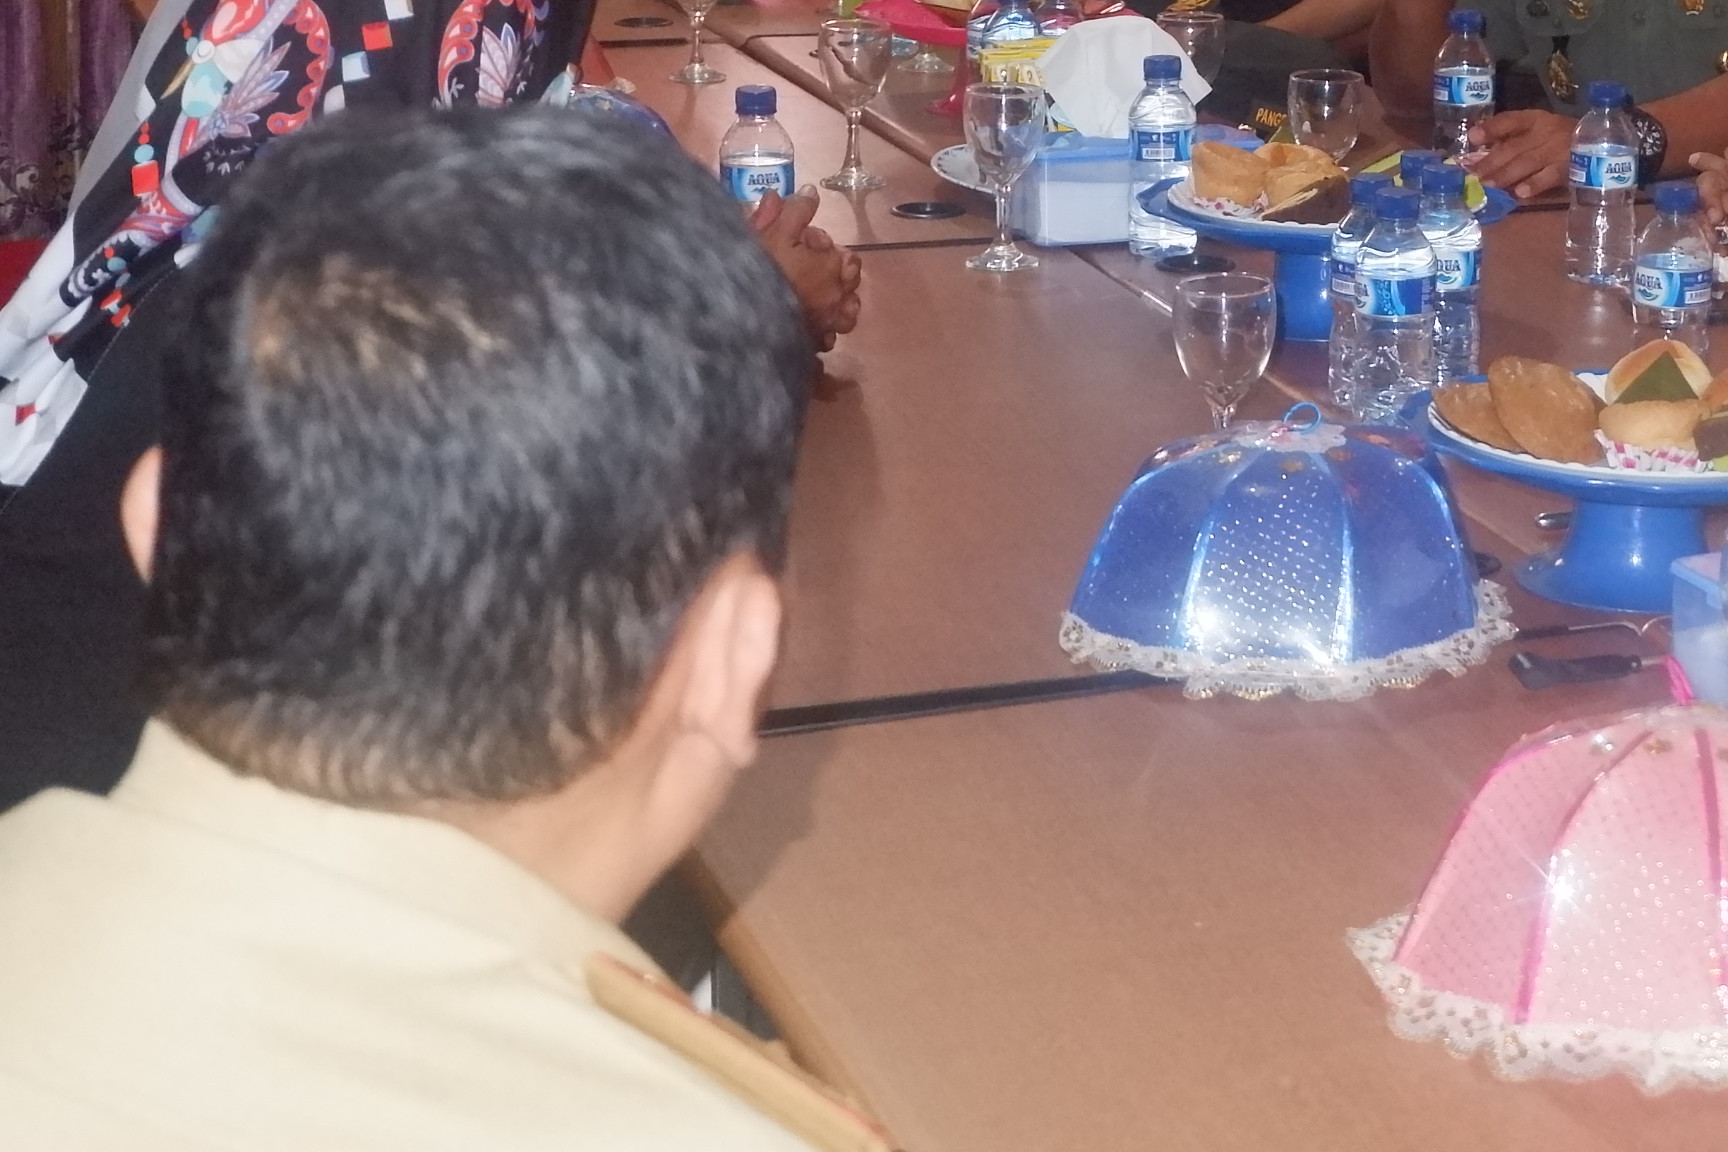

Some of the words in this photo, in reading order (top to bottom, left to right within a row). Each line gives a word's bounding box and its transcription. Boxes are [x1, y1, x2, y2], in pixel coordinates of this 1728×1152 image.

[1466, 80, 1490, 92] AQUA
[1256, 107, 1287, 127] PANG
[1605, 162, 1632, 176] AQUA
[747, 172, 780, 187] AQUA
[1437, 259, 1461, 272] QUA
[1635, 272, 1663, 290] AQUA
